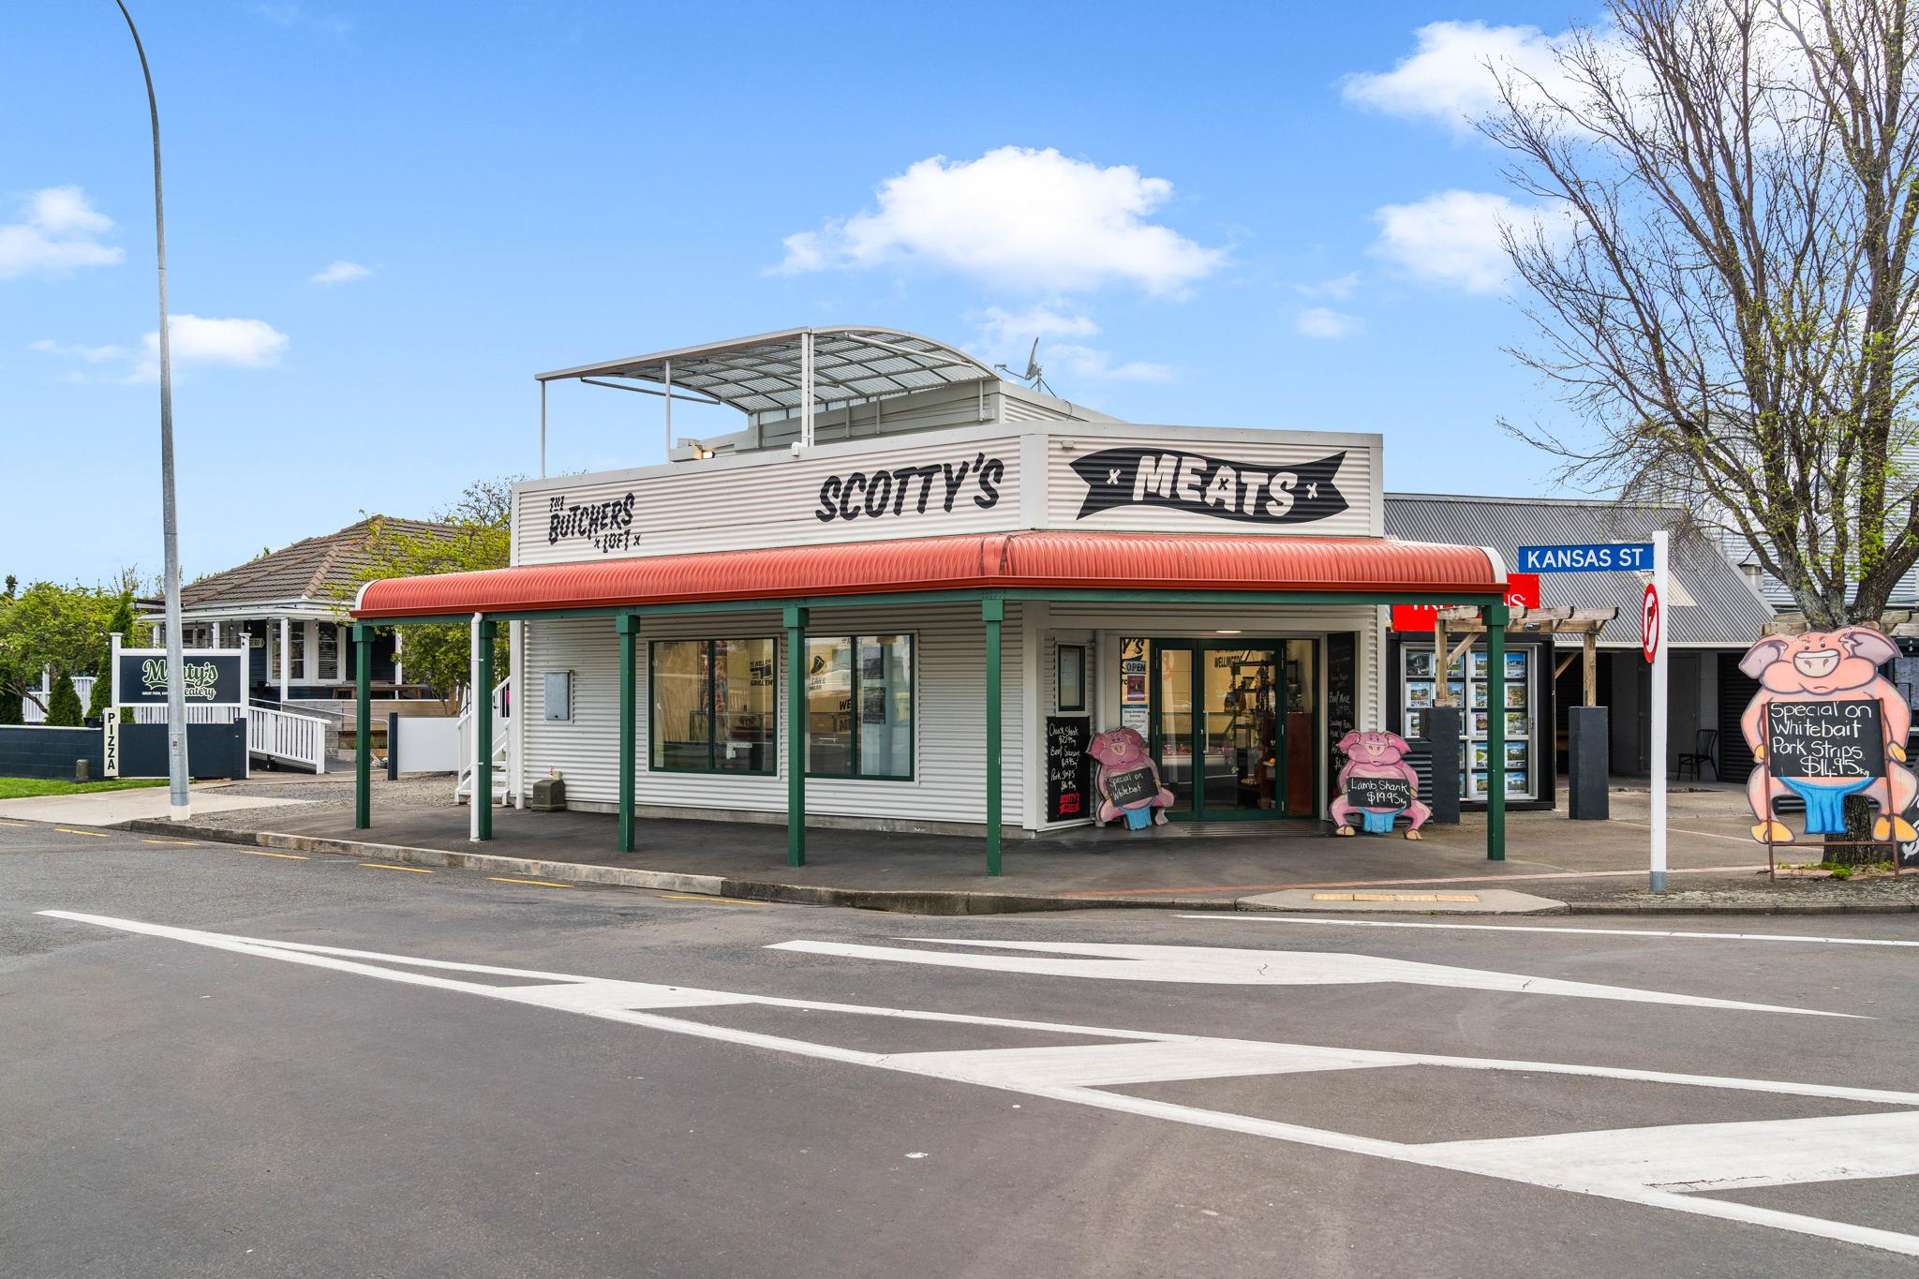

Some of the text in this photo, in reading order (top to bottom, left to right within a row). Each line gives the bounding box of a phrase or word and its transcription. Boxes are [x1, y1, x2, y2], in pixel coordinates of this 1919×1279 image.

[815, 452, 1005, 523] SCOTTY'S
[1132, 453, 1299, 517] MEATS
[548, 492, 636, 546] BUTCHERS
[602, 529, 631, 554] LOFT
[1527, 548, 1644, 569] KANSAS ST
[142, 659, 219, 688] Mty's
[1770, 702, 1872, 724] Special on
[107, 712, 116, 770] PIZZA
[1771, 718, 1862, 738] Whitebait
[1772, 736, 1863, 765] Pork Strips
[1351, 778, 1410, 796] Lamb Shank
